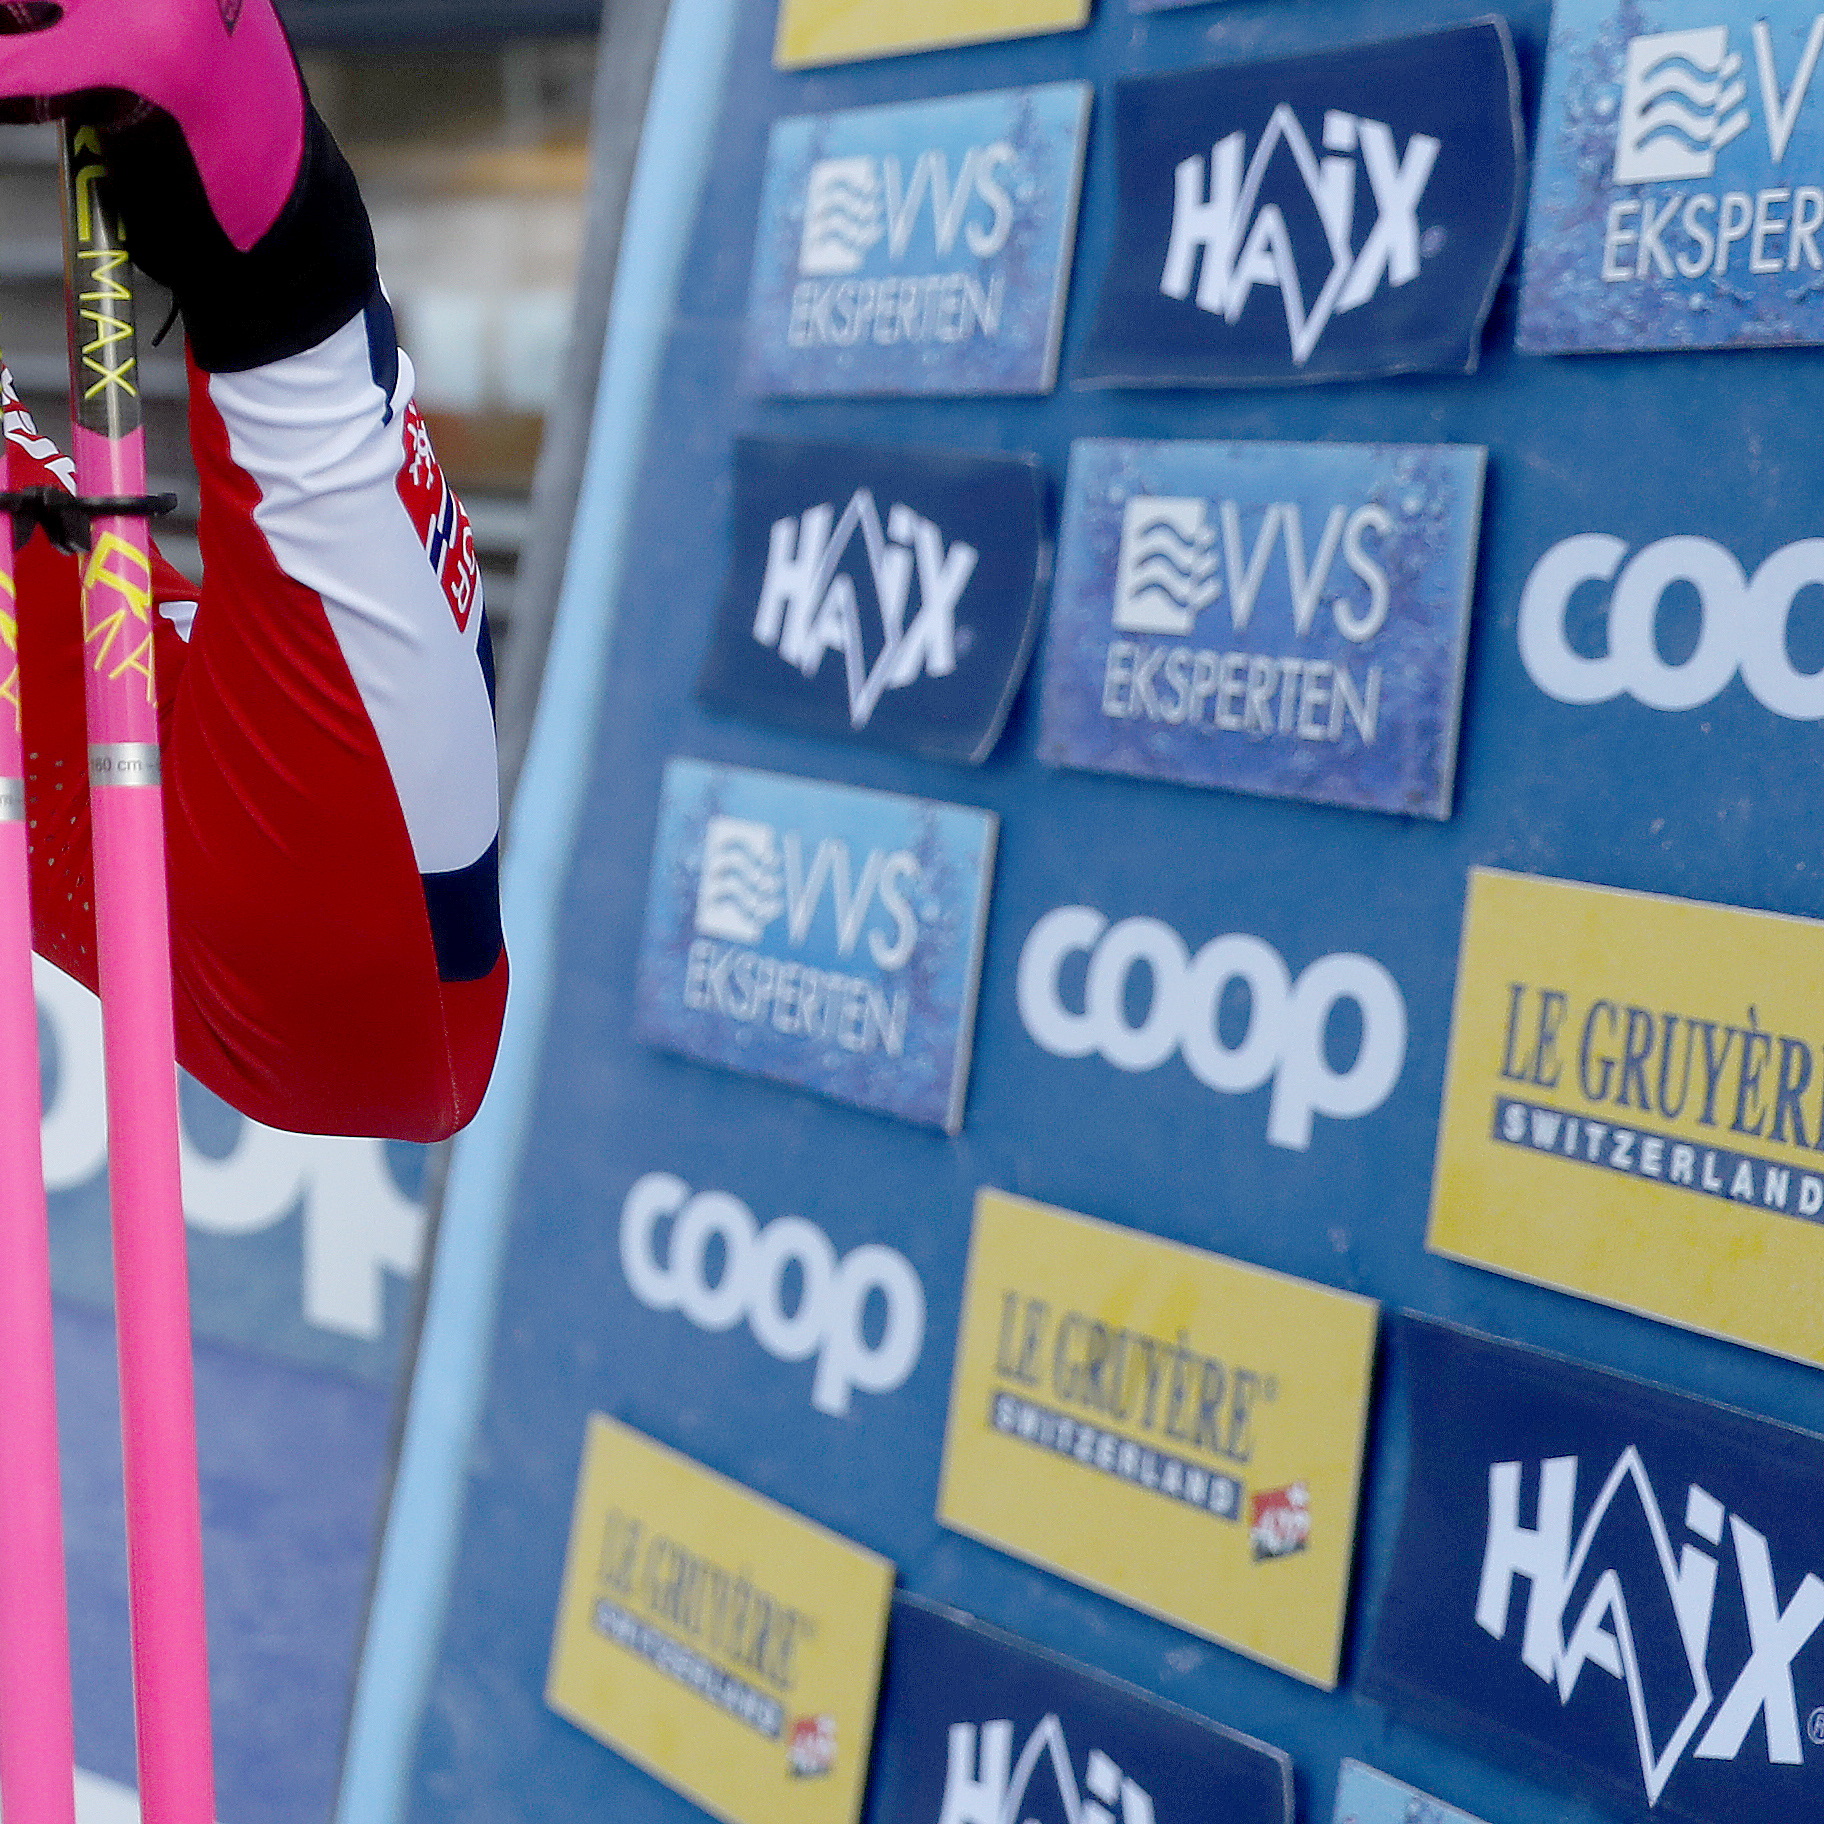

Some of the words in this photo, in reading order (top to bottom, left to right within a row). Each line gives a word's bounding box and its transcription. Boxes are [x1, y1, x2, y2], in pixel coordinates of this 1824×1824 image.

[883, 138, 1017, 262] VVS
[77, 250, 137, 399] MAX
[1220, 498, 1394, 643] VVS
[1102, 639, 1382, 747] EKSPERTEN
[783, 828, 923, 971] VVS
[1017, 903, 1407, 1151] coop
[1500, 981, 1567, 1089] LE
[1577, 1003, 1824, 1155] GRUYÈR
[1504, 1103, 1824, 1216] SWITZERLAND
[619, 1170, 926, 1417] coop
